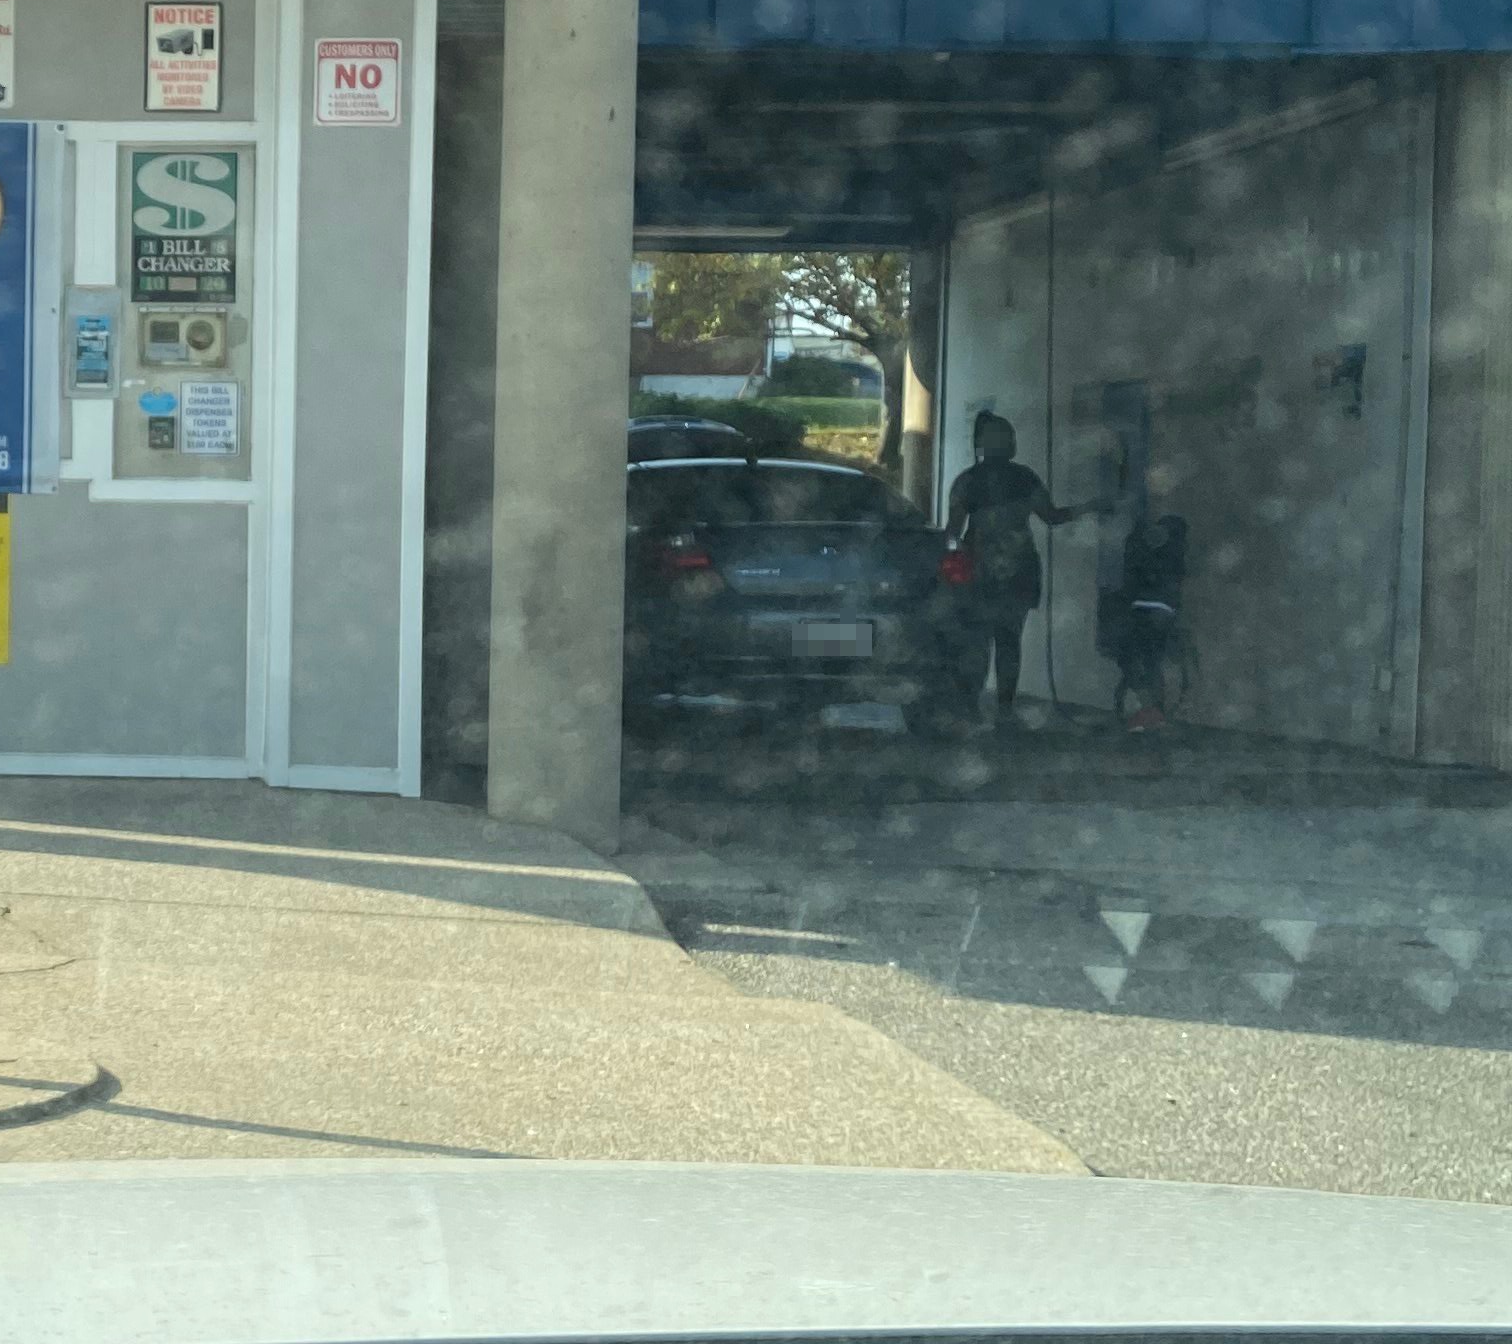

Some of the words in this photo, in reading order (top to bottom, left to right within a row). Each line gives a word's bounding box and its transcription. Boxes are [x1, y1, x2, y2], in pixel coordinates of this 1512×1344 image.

[153, 7, 214, 25] NOTICE
[319, 43, 373, 57] CUSTOMERS
[375, 43, 397, 57] ONLY
[335, 63, 383, 89] NO
[161, 239, 208, 255] BILL
[137, 256, 232, 272] CHANGER
